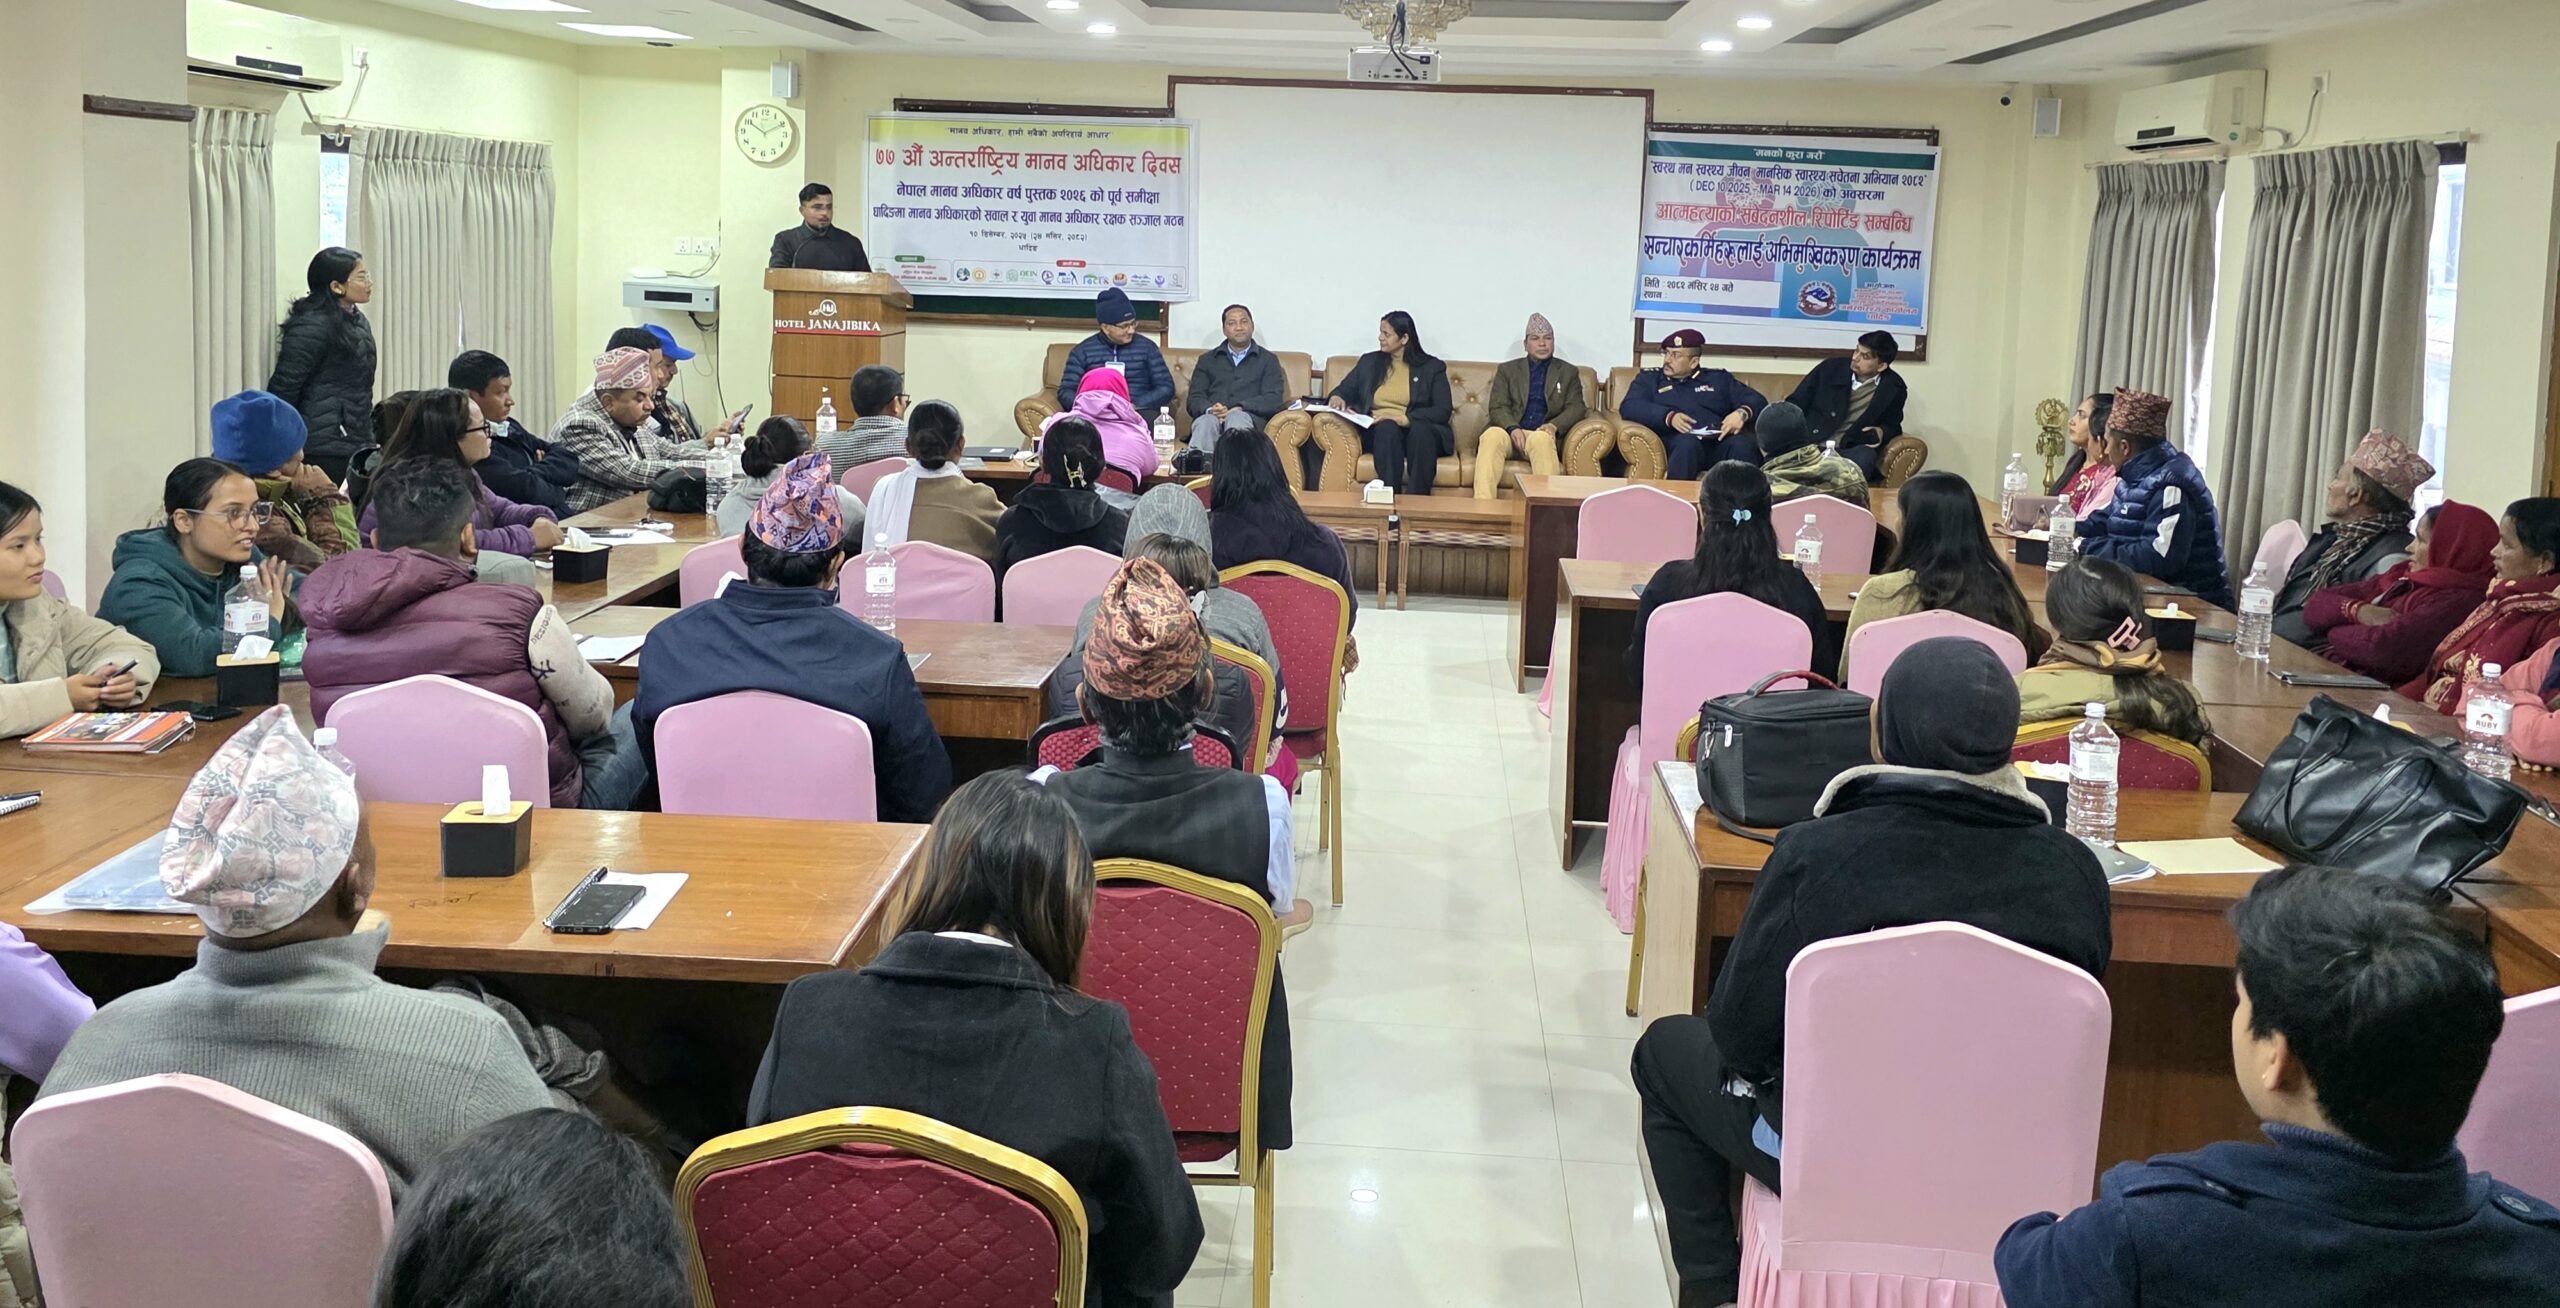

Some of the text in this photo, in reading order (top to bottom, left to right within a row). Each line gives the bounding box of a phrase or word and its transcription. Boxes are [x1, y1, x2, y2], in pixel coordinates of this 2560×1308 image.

[876, 148, 895, 165] ७७
[1025, 153, 1067, 170] मानव
[1073, 148, 1136, 173] अधिकार
[1142, 150, 1182, 177] दिवस
[1678, 163, 1693, 175] मन
[1727, 162, 1751, 178] जीवन
[1756, 164, 1792, 180] मानसिक
[1829, 168, 1860, 183] सचेतना
[1862, 169, 1899, 186] अभियान
[896, 181, 926, 198] नेपाल
[930, 185, 957, 198] मानव
[961, 183, 1003, 199] अधिकार
[1007, 184, 1022, 199] वर्ष
[1025, 188, 1057, 204] पुस्तक
[1090, 187, 1104, 202] को
[1108, 188, 1122, 206] पूर्व
[1125, 188, 1160, 205] समीक्षा
[1696, 180, 1715, 192] DEC
[1718, 181, 1726, 192] 10
[1728, 182, 1750, 193] 2025
[1760, 184, 1781, 195] MAR
[1783, 185, 1791, 196] 14
[1823, 185, 1836, 198] को
[1840, 189, 1884, 200] अवसरमा
[908, 207, 932, 219] मानव
[934, 204, 981, 221] अधिकारको
[984, 209, 1008, 222] सवाल
[1011, 211, 1018, 222] र
[1021, 211, 1037, 226] युवा
[1039, 211, 1062, 224] मानव
[1065, 209, 1100, 225] अधिकार
[1103, 213, 1126, 226] रक्षक
[1164, 215, 1185, 227] गठन
[1656, 202, 1737, 223] आत्महत्याको
[1862, 241, 1921, 271] कार्यक्रम
[775, 319, 881, 331] HOTEL JANAJIBIKA
